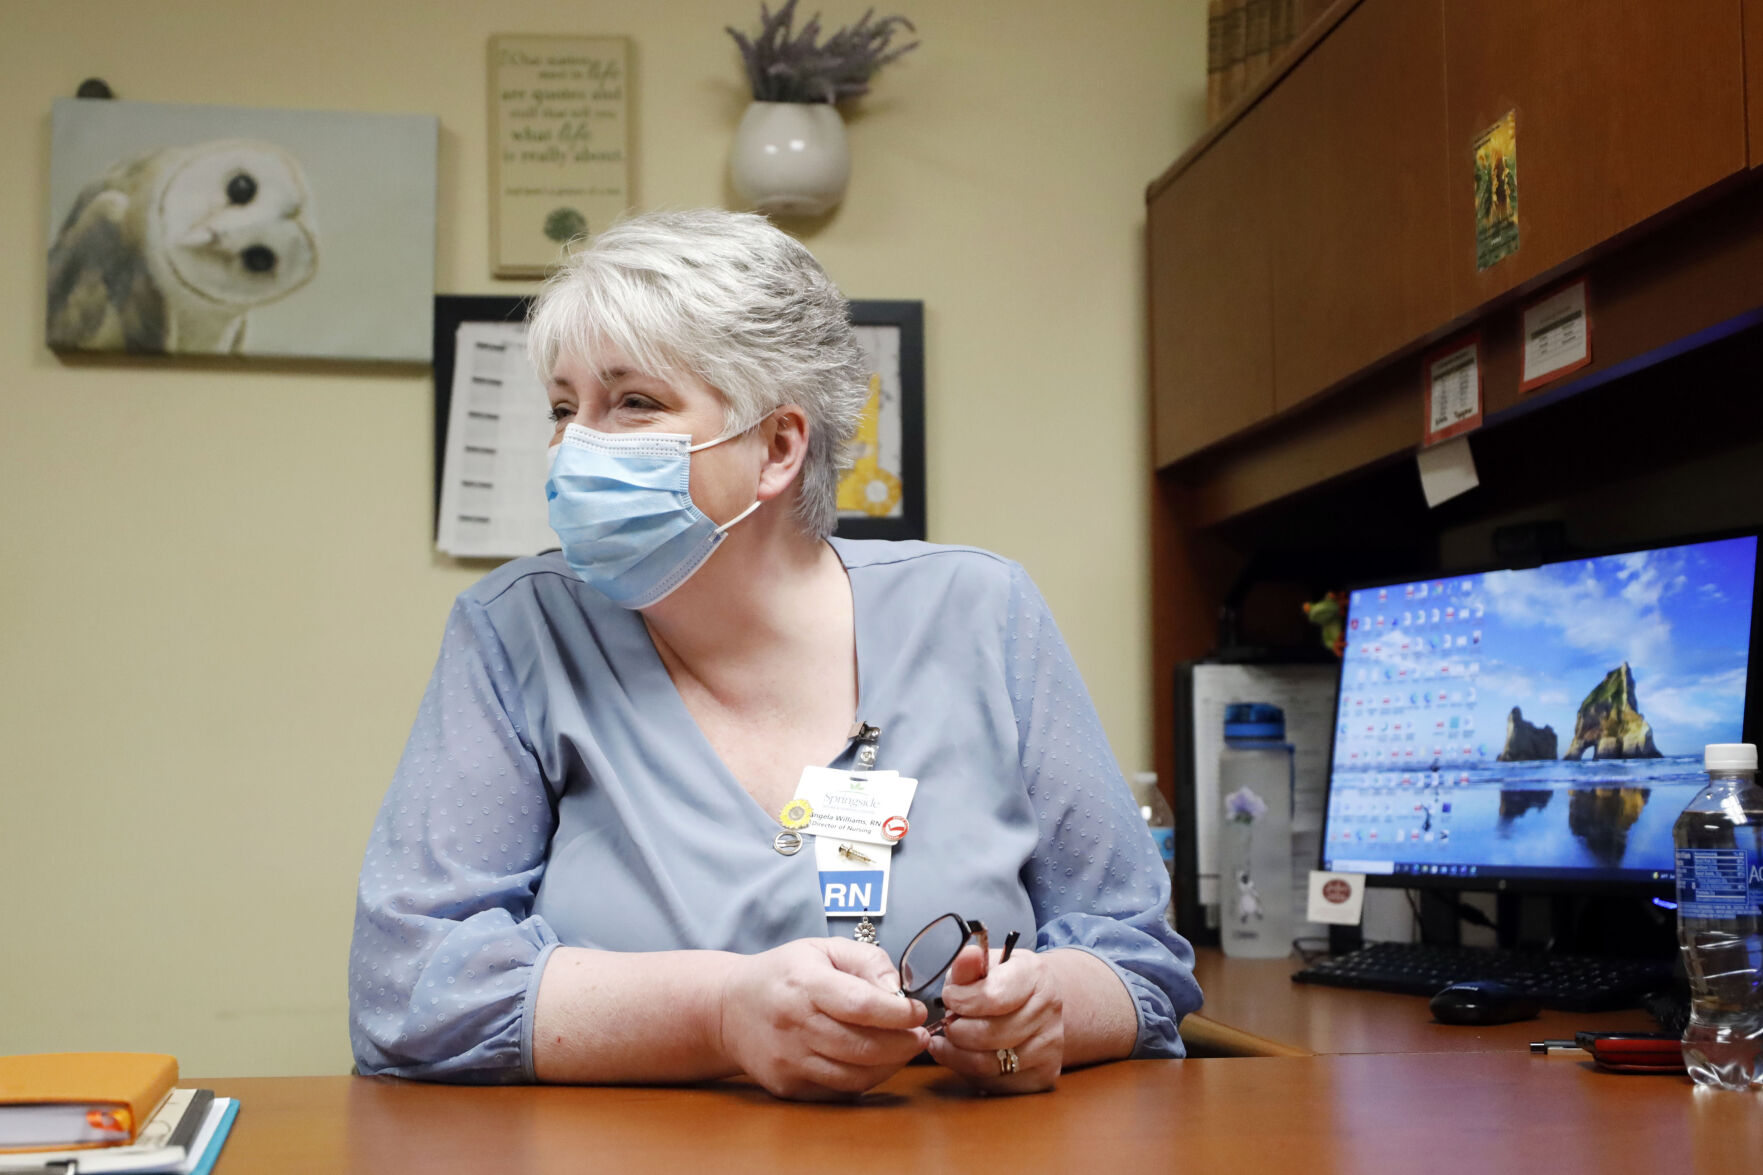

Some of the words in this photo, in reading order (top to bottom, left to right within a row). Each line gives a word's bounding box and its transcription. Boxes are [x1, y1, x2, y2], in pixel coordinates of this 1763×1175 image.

[811, 820, 837, 829] Director
[846, 825, 872, 834] Nursing
[870, 819, 882, 827] RN
[824, 883, 872, 907] RN
